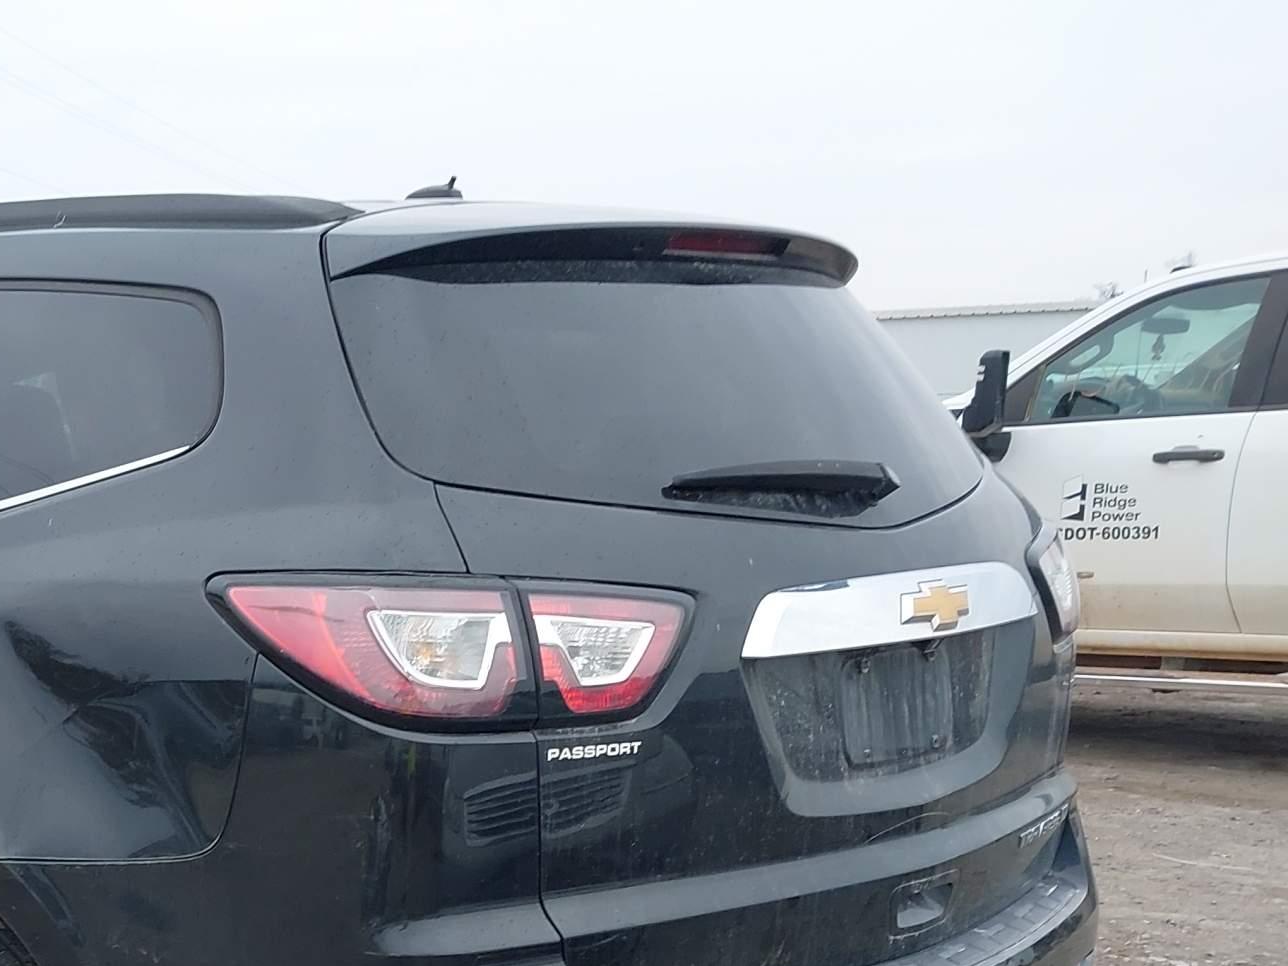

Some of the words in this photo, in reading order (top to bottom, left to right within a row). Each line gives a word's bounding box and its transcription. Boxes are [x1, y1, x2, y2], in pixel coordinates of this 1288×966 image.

[1094, 483, 1129, 494] Blue
[1092, 497, 1137, 510] Ridge
[1091, 511, 1141, 522] Power
[1059, 525, 1160, 540] DOT-600391
[547, 741, 642, 762] PASSPORT
